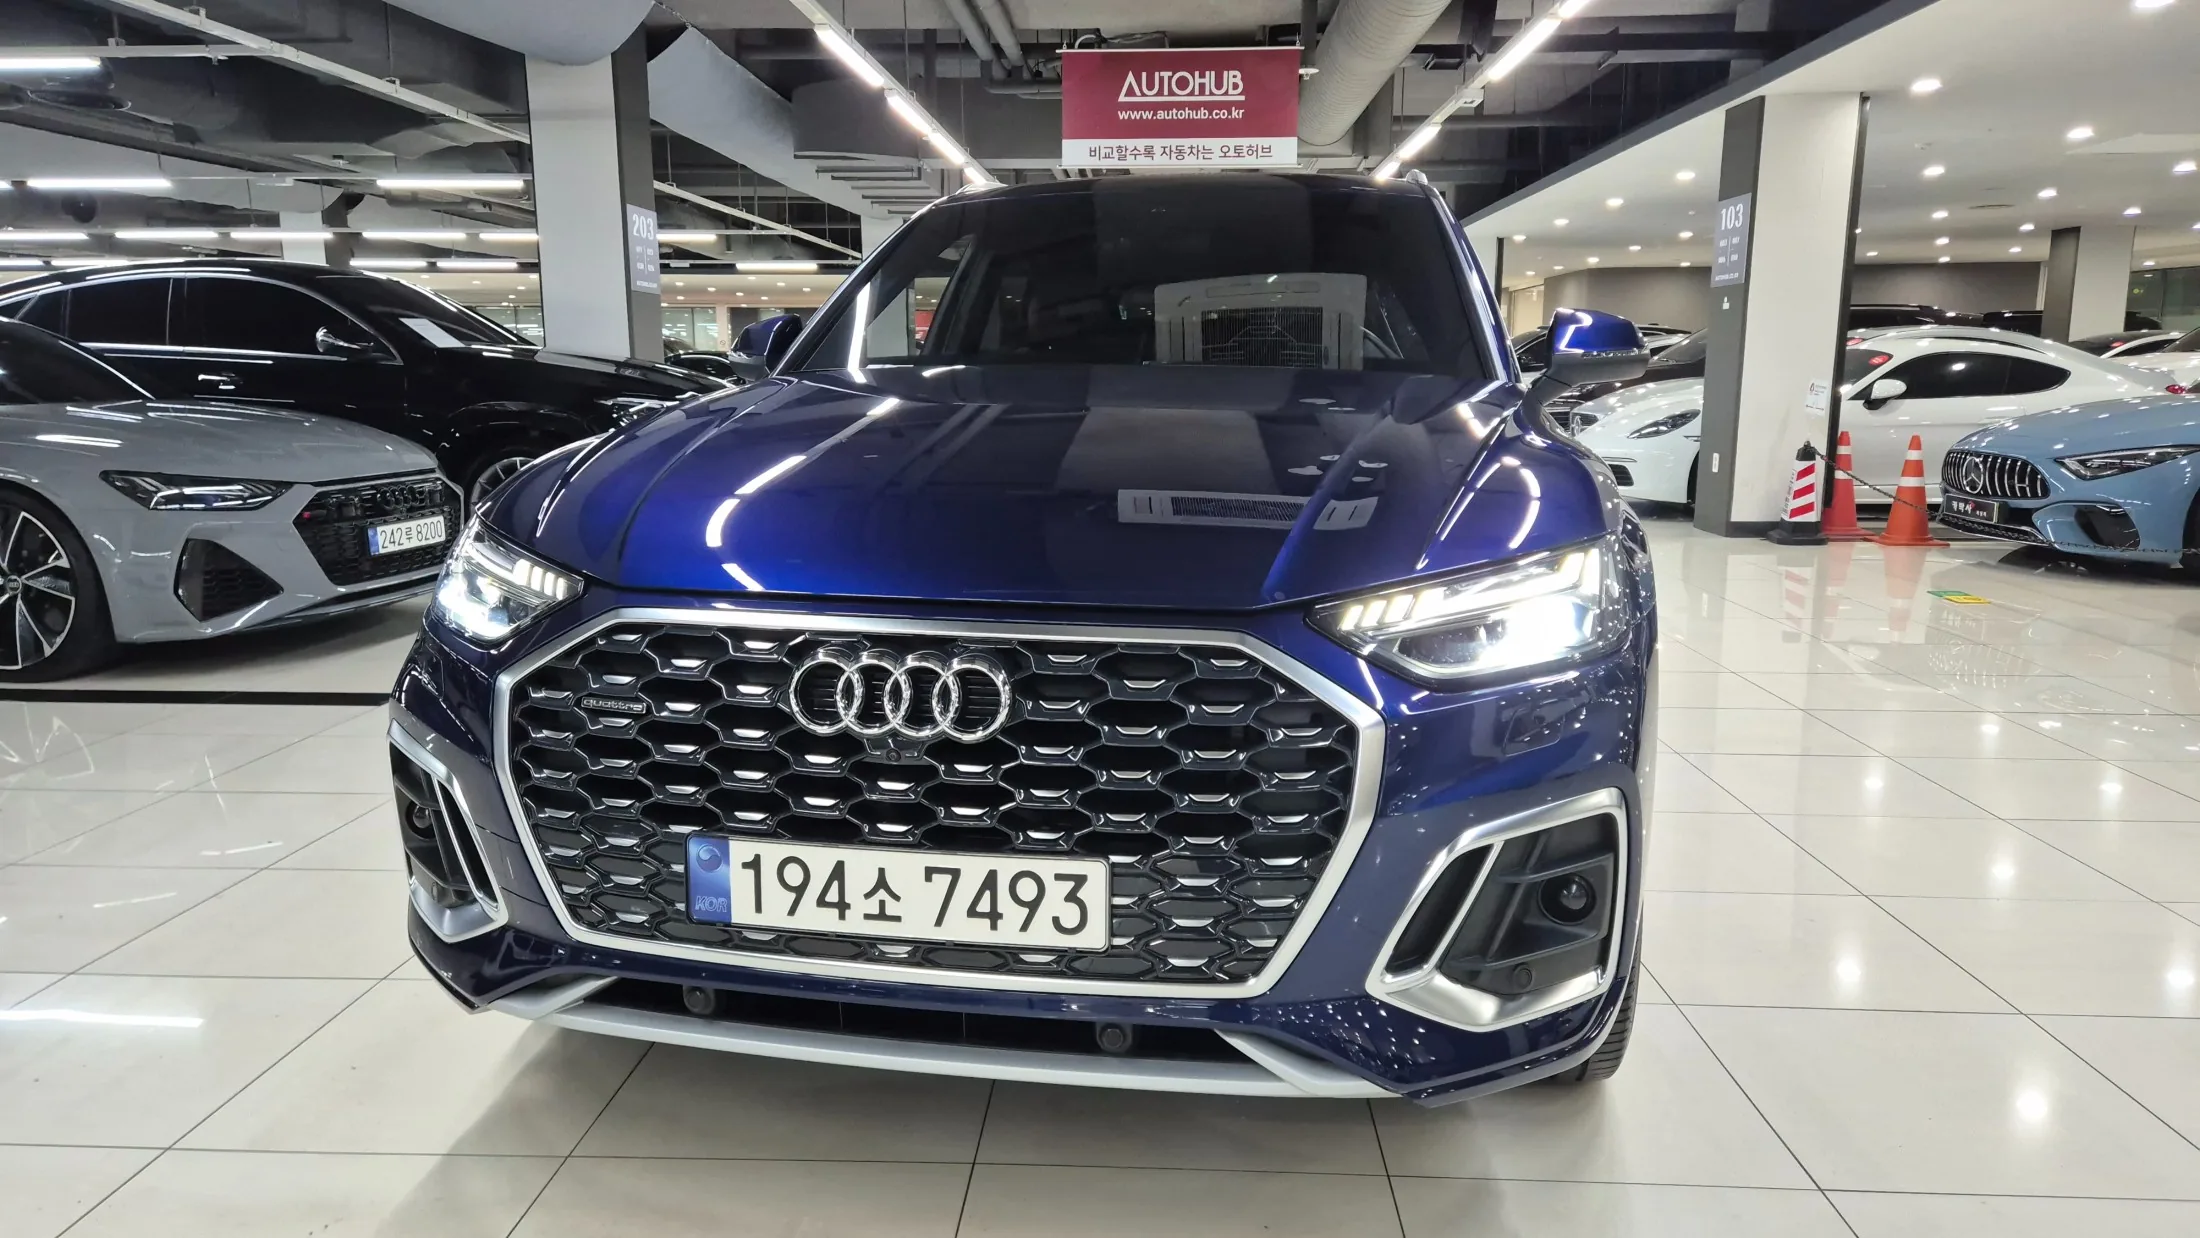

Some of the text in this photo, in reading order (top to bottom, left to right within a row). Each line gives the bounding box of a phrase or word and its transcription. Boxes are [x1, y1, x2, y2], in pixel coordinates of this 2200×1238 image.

[1118, 70, 1245, 102] AUTOHUB
[1118, 106, 1244, 120] www.autohub.co.kr
[1089, 143, 1273, 161] 비교할수록 자동차는 오토허브
[632, 213, 654, 241] 203
[1720, 203, 1744, 231] 103
[380, 520, 443, 549] 242루 8200
[583, 699, 643, 711] quattro
[695, 895, 728, 913] KOR
[741, 853, 1089, 936] 194소 7493
